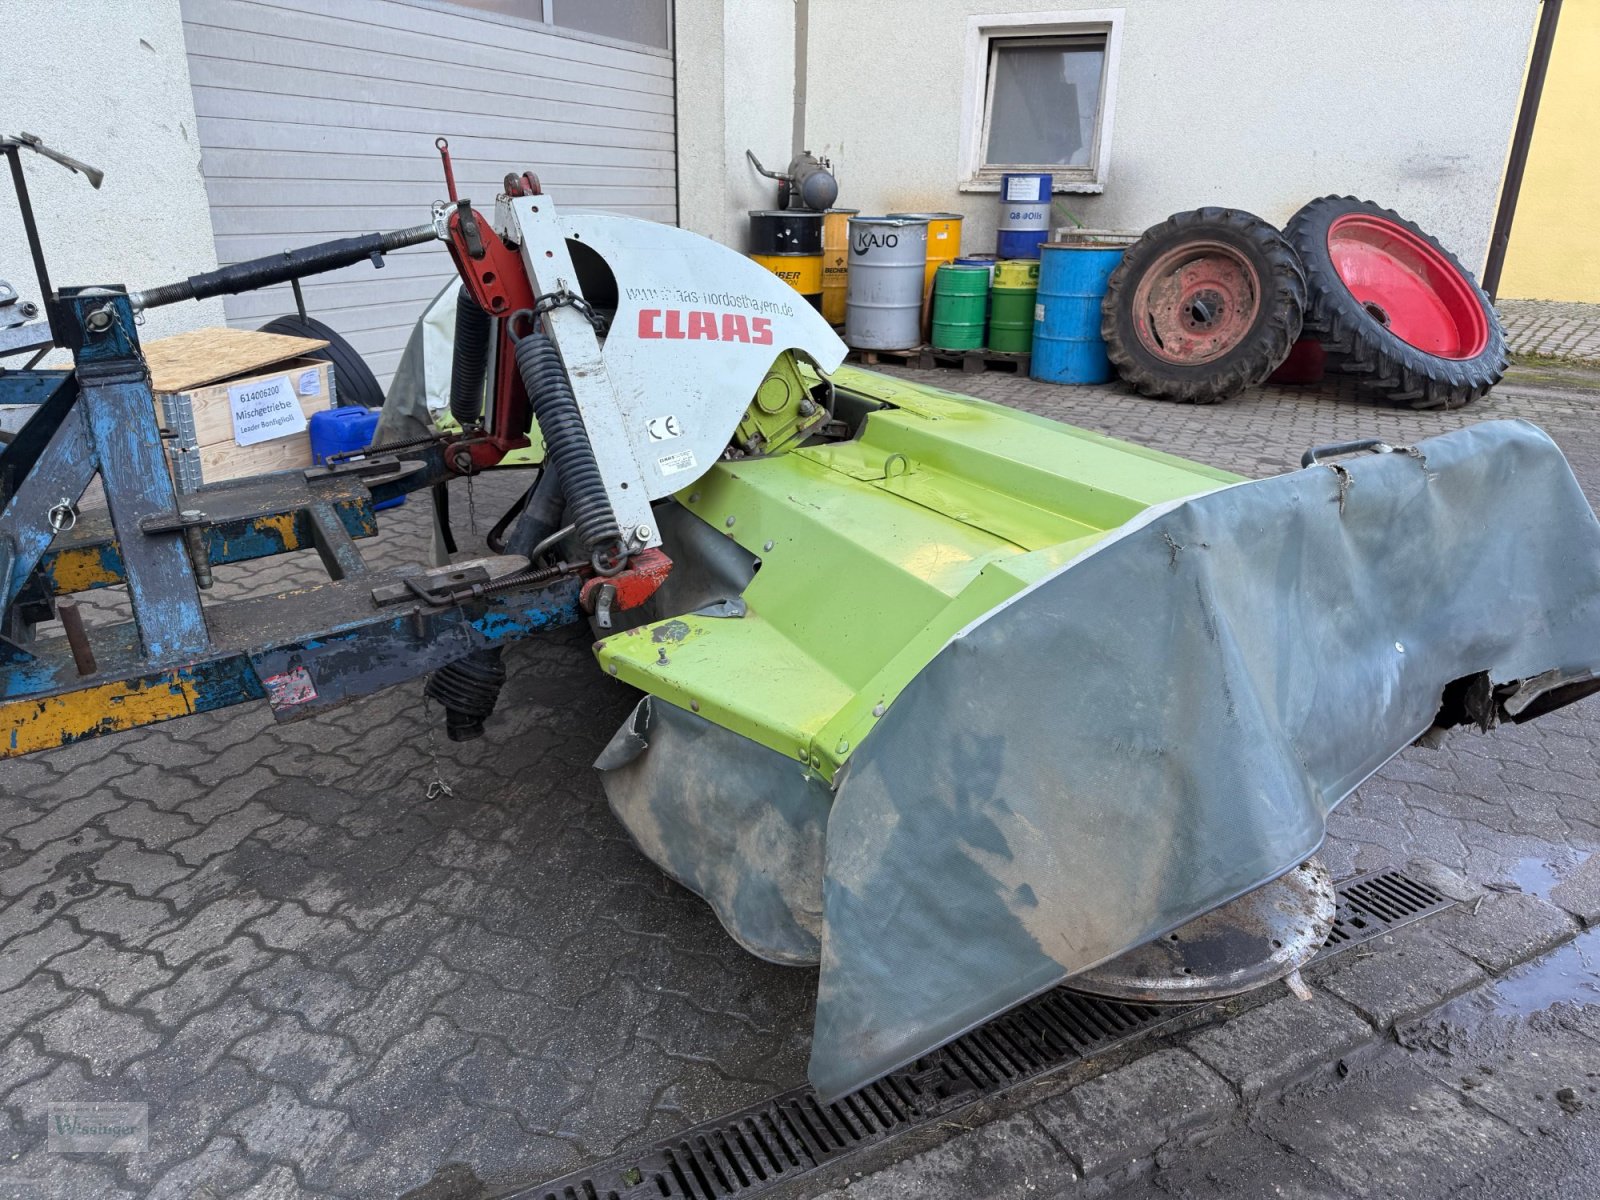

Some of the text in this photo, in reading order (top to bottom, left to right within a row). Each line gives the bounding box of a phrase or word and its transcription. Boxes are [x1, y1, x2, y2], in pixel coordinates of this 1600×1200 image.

[858, 232, 899, 248] KAJO
[638, 309, 773, 346] CLAAS
[240, 385, 280, 403] 614006200
[236, 400, 292, 421] Mischgetriebe
[240, 414, 295, 434] Leader Bonfiglioli
